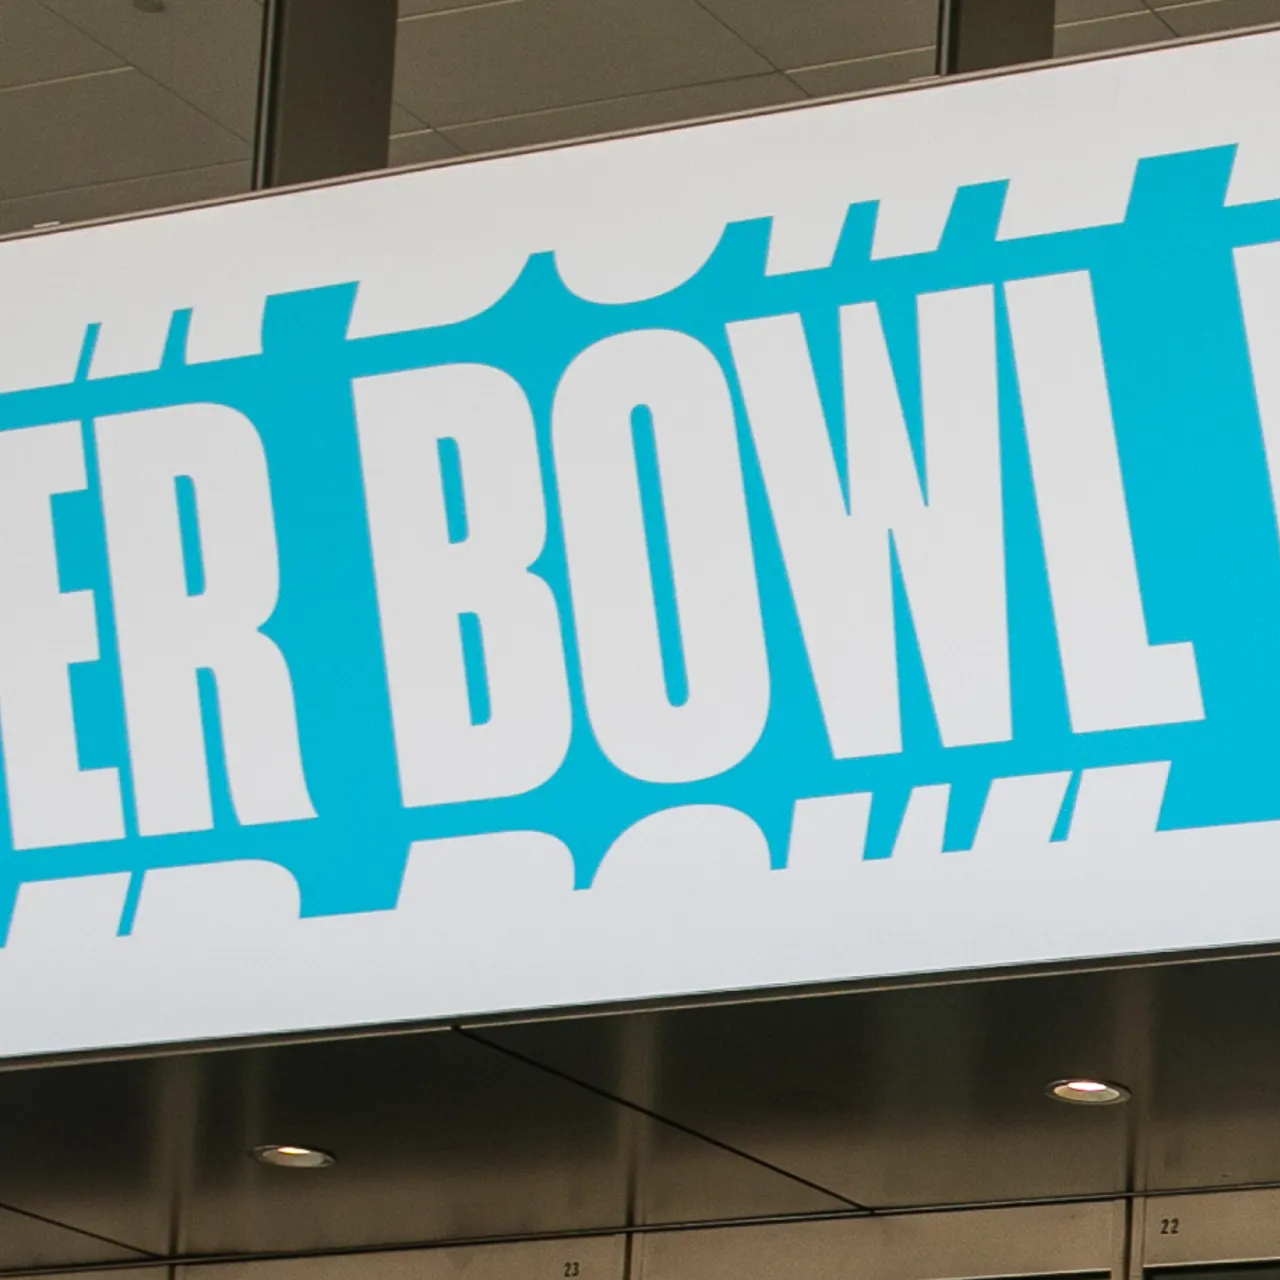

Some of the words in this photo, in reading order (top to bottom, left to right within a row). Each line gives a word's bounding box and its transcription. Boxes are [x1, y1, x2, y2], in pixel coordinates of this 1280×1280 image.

[352, 270, 1205, 808] BOWL
[1160, 1218, 1180, 1235] 22
[563, 1261, 580, 1278] 23
